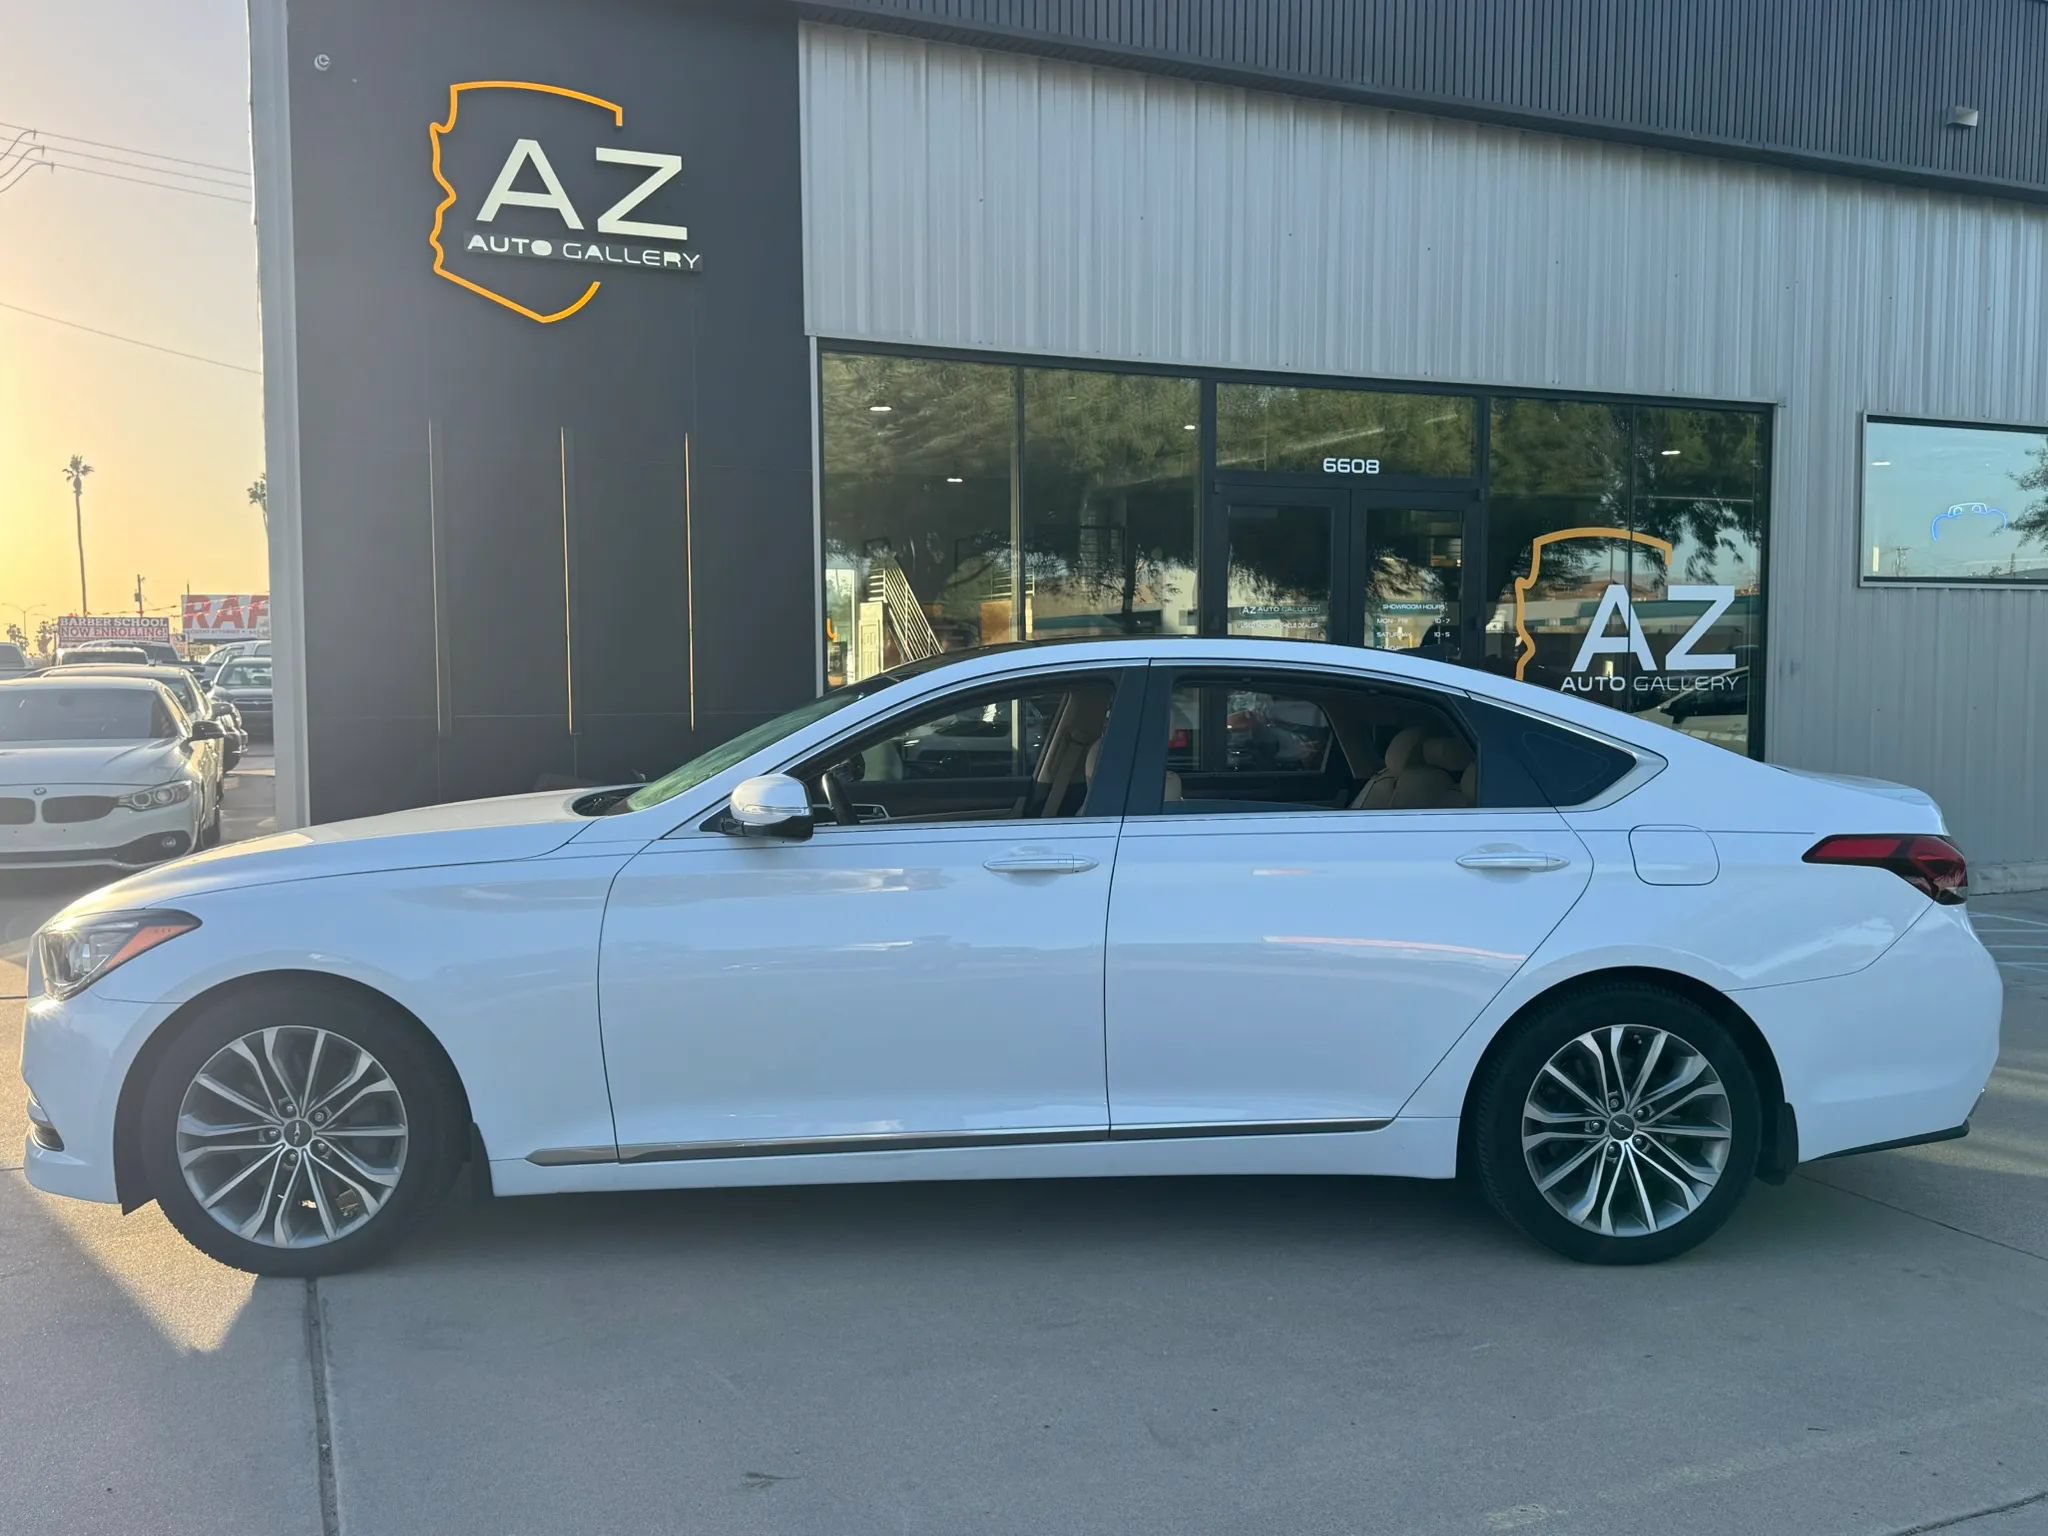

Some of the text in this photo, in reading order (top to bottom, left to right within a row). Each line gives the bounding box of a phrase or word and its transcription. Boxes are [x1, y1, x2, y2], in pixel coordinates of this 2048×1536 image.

[476, 138, 688, 241] AZ
[467, 234, 700, 269] AUTO GALLERY
[1323, 457, 1380, 474] 6608
[1242, 606, 1256, 614] AZ
[60, 618, 167, 626] BARBER SCHOOL
[1571, 584, 1736, 672] AZ
[61, 627, 167, 637] NOW ENROLLING!
[1560, 676, 1740, 692] AUTO GALLERY
